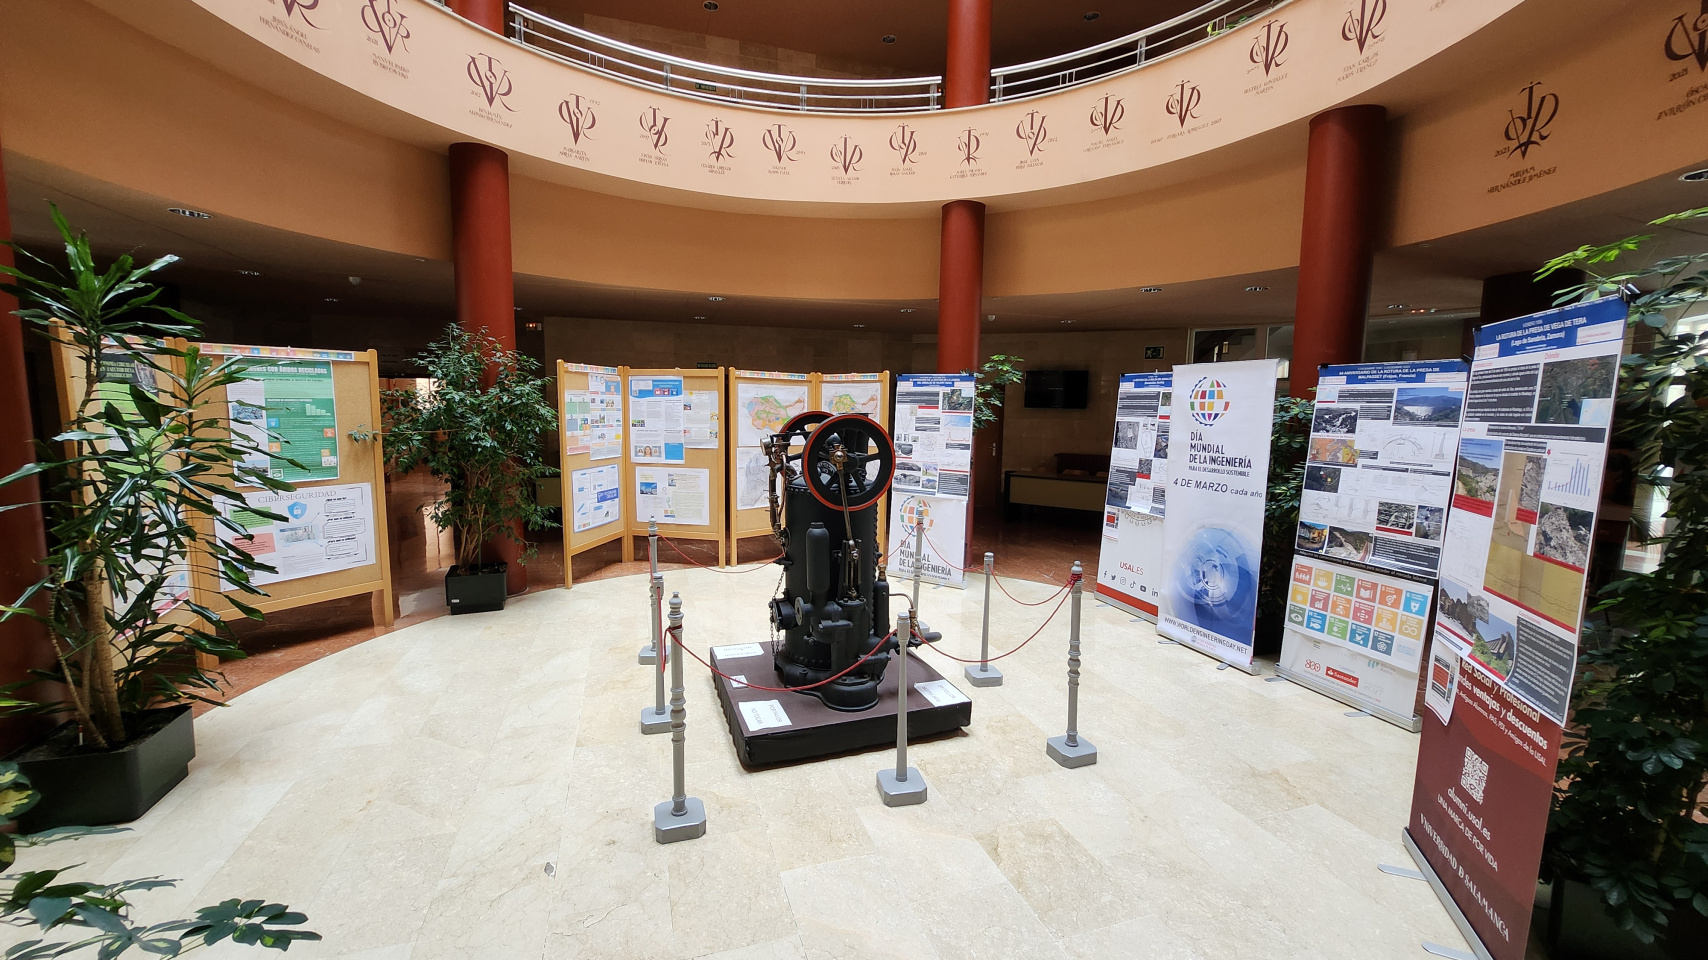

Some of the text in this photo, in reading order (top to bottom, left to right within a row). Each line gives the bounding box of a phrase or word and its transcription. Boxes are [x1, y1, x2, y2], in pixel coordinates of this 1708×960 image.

[1488, 166, 1557, 194] HERNÁNDEZ JIMÉNEZ
[1508, 166, 1536, 178] MIRIAM
[1528, 325, 1543, 334] PRESA
[1551, 322, 1564, 330] VEGA
[1572, 317, 1587, 325] TERA
[1190, 429, 1202, 441] DÍA
[1190, 443, 1225, 454] MUNDIAL
[1189, 454, 1252, 469] DE LA INGENIERÍA
[1180, 478, 1192, 487] DE
[1194, 480, 1228, 493] MARZO
[1230, 488, 1247, 496] cada
[258, 490, 337, 503] CIBERSEGURIDAD
[899, 558, 906, 567] DE
[908, 560, 914, 568] LA
[900, 549, 930, 562] MUNAL
[1120, 561, 1143, 575] USAL.ES
[1164, 617, 1248, 654] WWW.WORLDENGINEERINGDAY.NET
[1334, 672, 1357, 684] Santander
[1462, 658, 1540, 723] Red Social y Profesional
[1473, 686, 1500, 712] ventajas
[1500, 706, 1506, 718] y
[1507, 709, 1548, 750] descuentos
[1508, 729, 1523, 748] Amigos
[1523, 742, 1530, 752] de
[1448, 787, 1491, 840] alumni.usal.es
[1438, 794, 1498, 872] UNA MARCA DE POR VIDA
[1464, 875, 1509, 942] SALAMANCA
